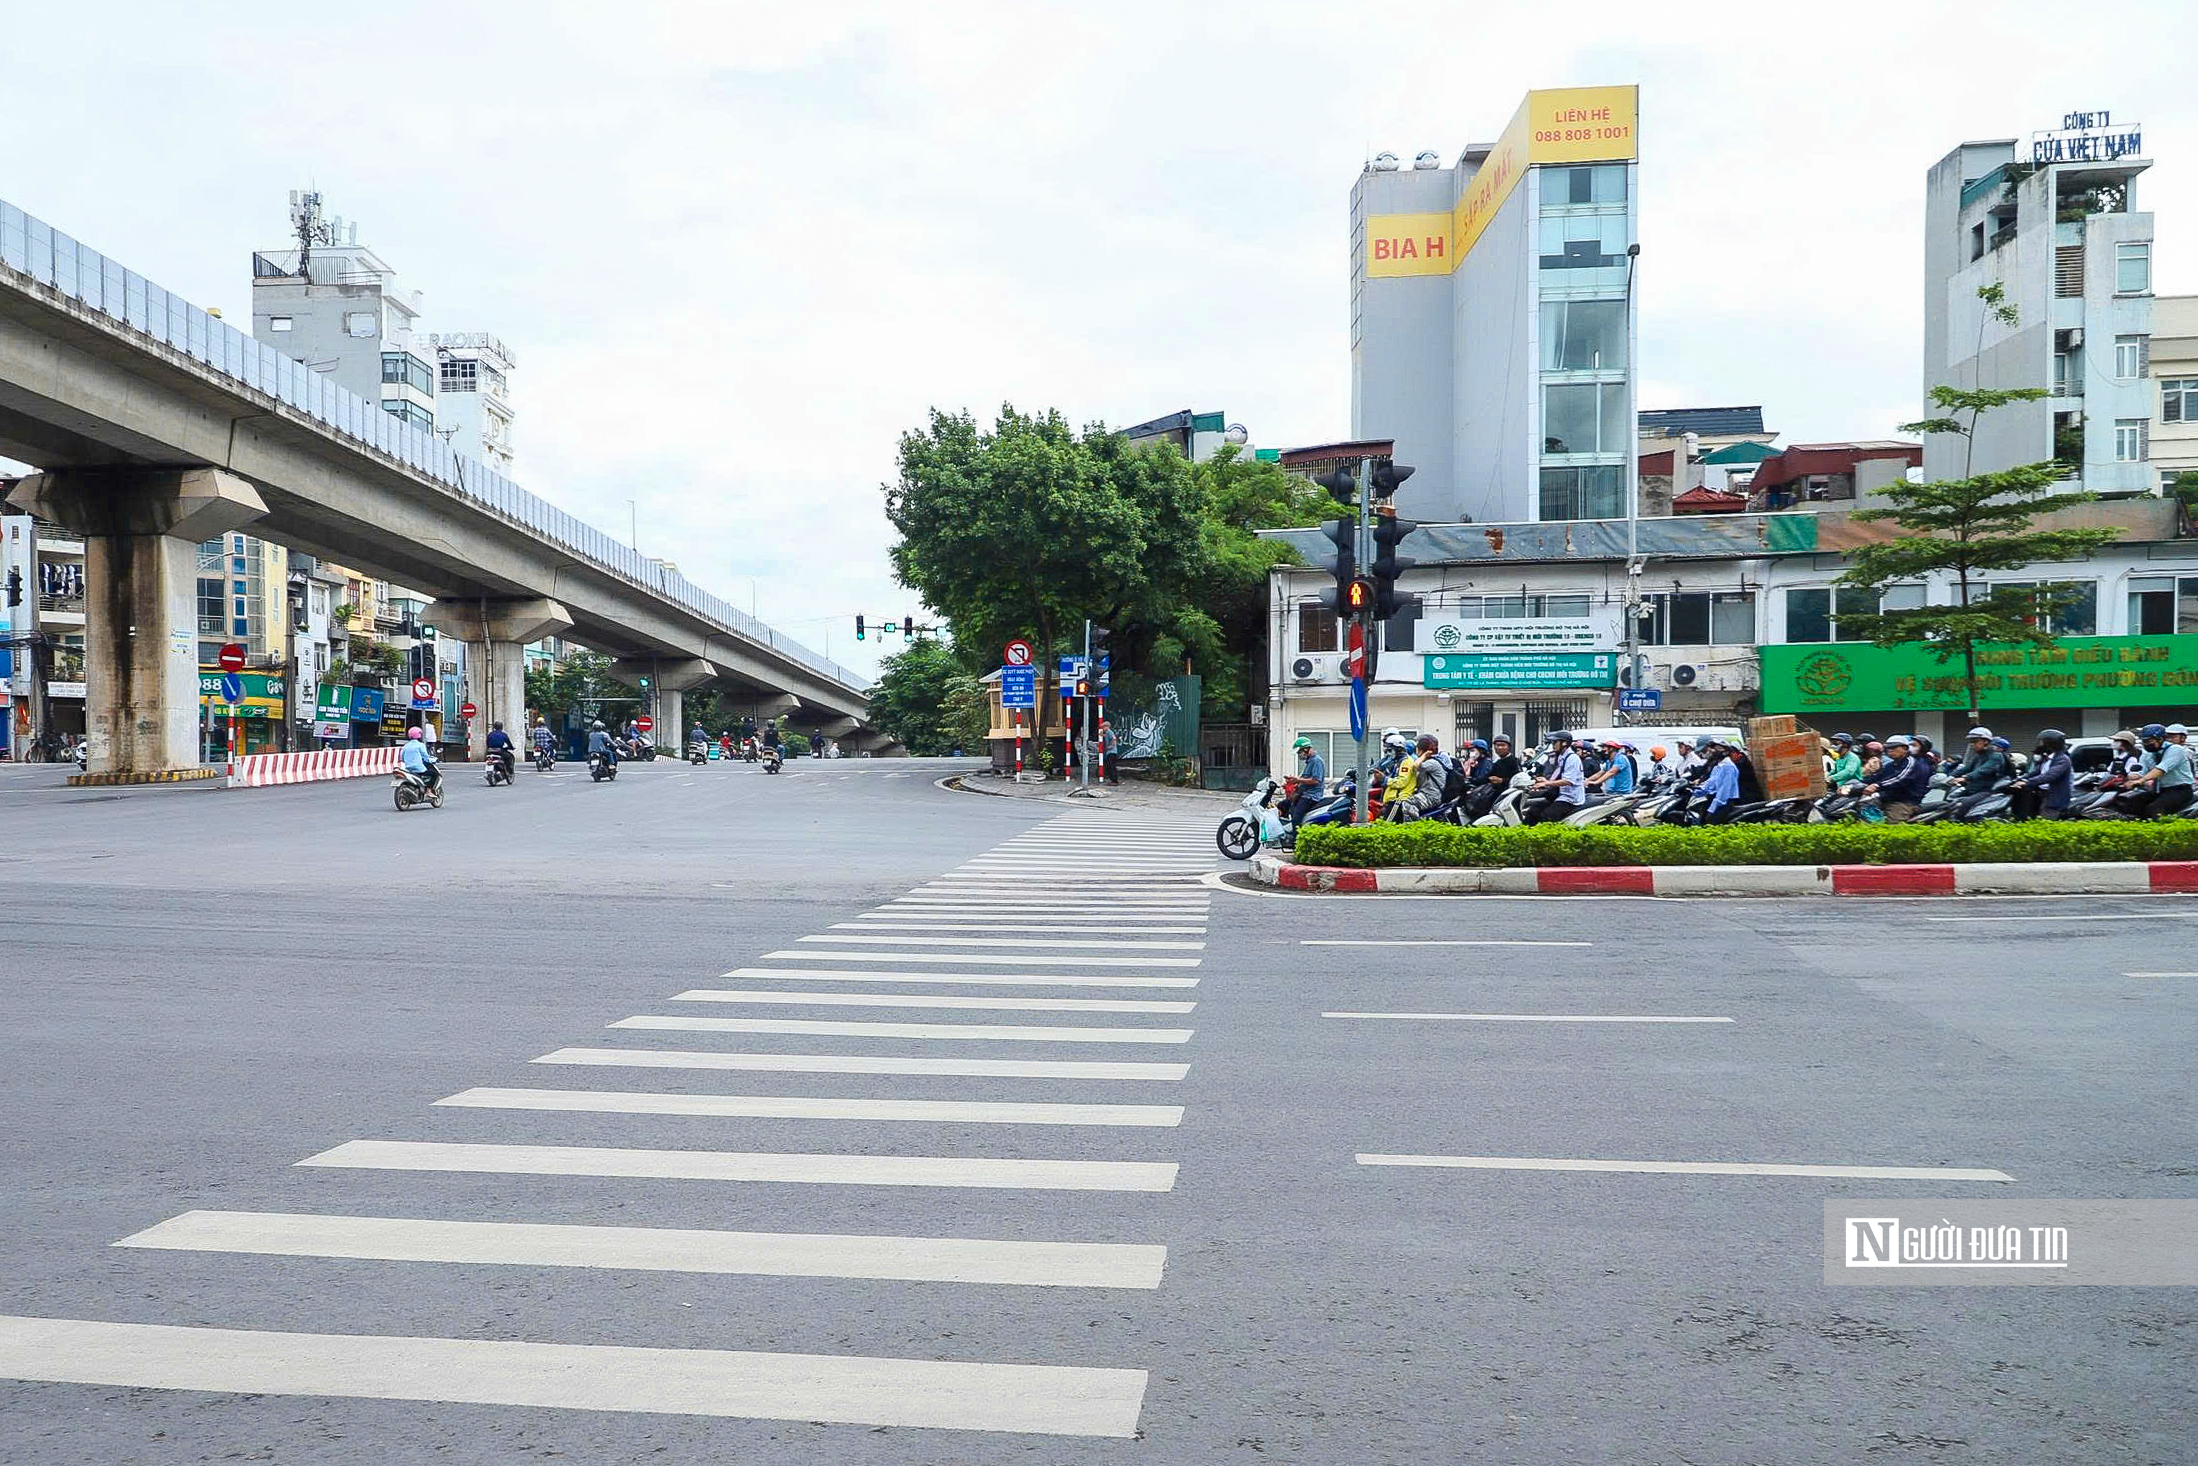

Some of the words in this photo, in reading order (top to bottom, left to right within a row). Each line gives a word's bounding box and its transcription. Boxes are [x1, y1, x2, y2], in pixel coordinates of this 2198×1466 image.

[1555, 108, 1587, 123] LIÊN
[1591, 105, 1611, 124] HỆ
[1535, 129, 1562, 143] 088
[1565, 127, 1592, 142] 808
[1596, 125, 1630, 140] 1001
[2068, 133, 2100, 160] VIỆT
[2105, 132, 2141, 155] NAM
[1374, 236, 1418, 260] BIA
[1426, 235, 1444, 258] H
[1975, 650, 2025, 665] RUNG
